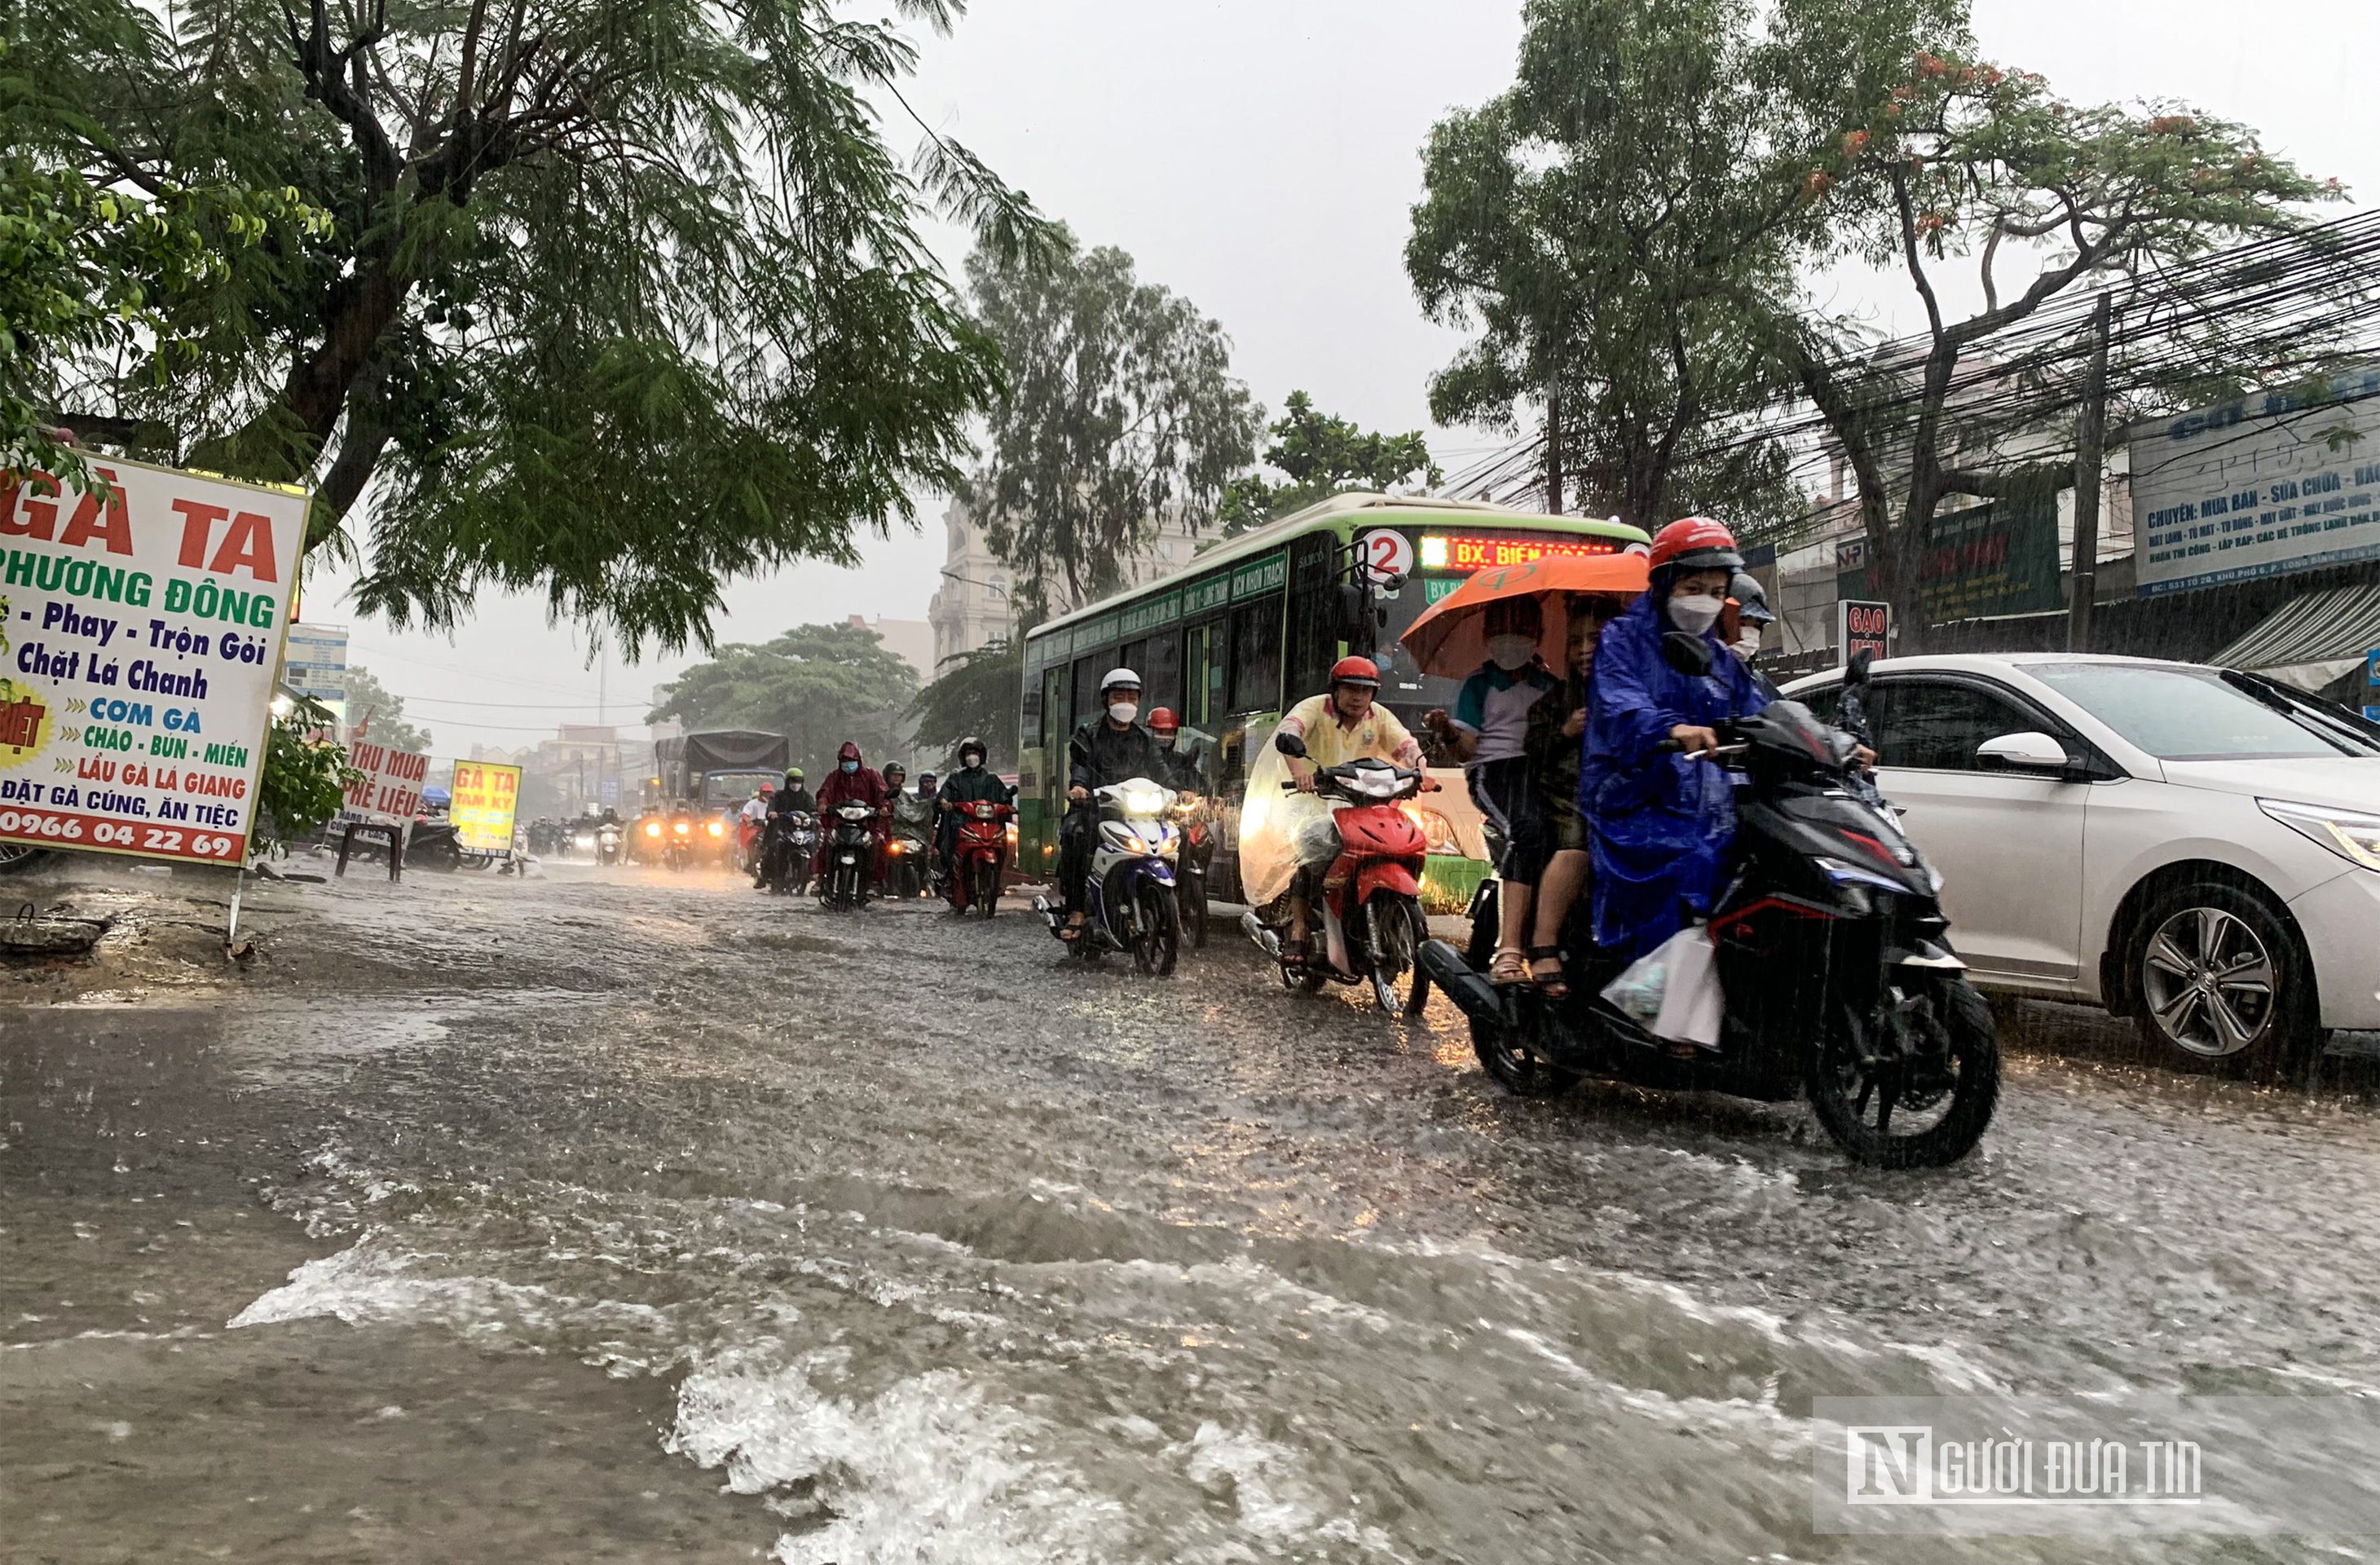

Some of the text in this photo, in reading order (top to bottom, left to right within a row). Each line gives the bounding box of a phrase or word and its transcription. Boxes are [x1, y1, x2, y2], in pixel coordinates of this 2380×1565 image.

[2148, 502, 2197, 529] CHUYÊN:
[2201, 496, 2228, 518] MUA
[2232, 489, 2258, 511] BÁN
[2271, 478, 2298, 504] SỬA
[172, 498, 277, 583] TA
[1372, 536, 1399, 574] 2
[2188, 543, 2210, 556] CÔNG
[2257, 530, 2275, 544] CÁC
[2217, 571, 2235, 581] KHU
[2282, 558, 2308, 571] LONG
[165, 577, 275, 629] ĐÔNG
[1849, 606, 1885, 638] GẠO
[42, 602, 117, 646] Phay
[149, 619, 209, 659] Trộn
[219, 632, 267, 665] Gỏi
[17, 642, 208, 699] Chặt Lá Chanh
[90, 697, 201, 734] CƠM GÀ
[84, 725, 248, 769] CHÁO BÚN MIẾN
[350, 741, 425, 782] THU MUA
[77, 752, 245, 800] LẨU GÀ LÁ GIANG
[455, 765, 515, 794] GÀ TA
[1, 778, 239, 828] ĐẶT GÀ CÚNG, ĂN TIỆC
[377, 784, 418, 820] LIỆU
[455, 792, 485, 807] TAM
[0, 811, 231, 857] 0966 04 22 69
